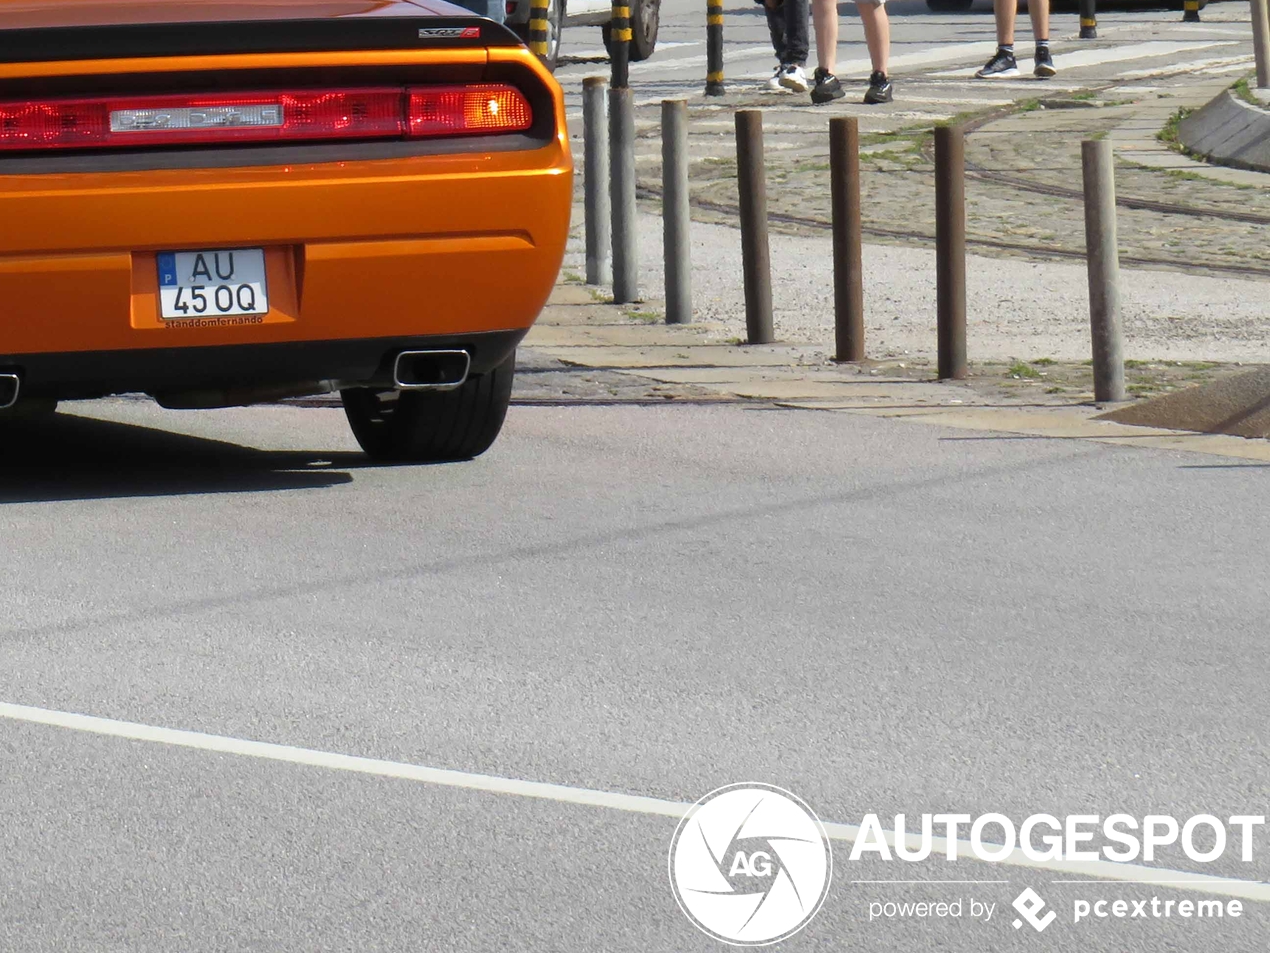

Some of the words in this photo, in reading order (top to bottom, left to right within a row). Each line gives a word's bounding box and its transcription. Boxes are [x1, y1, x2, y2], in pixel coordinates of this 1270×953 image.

[191, 252, 235, 281] AU
[164, 274, 172, 284] P
[165, 315, 263, 329] standdomfernando
